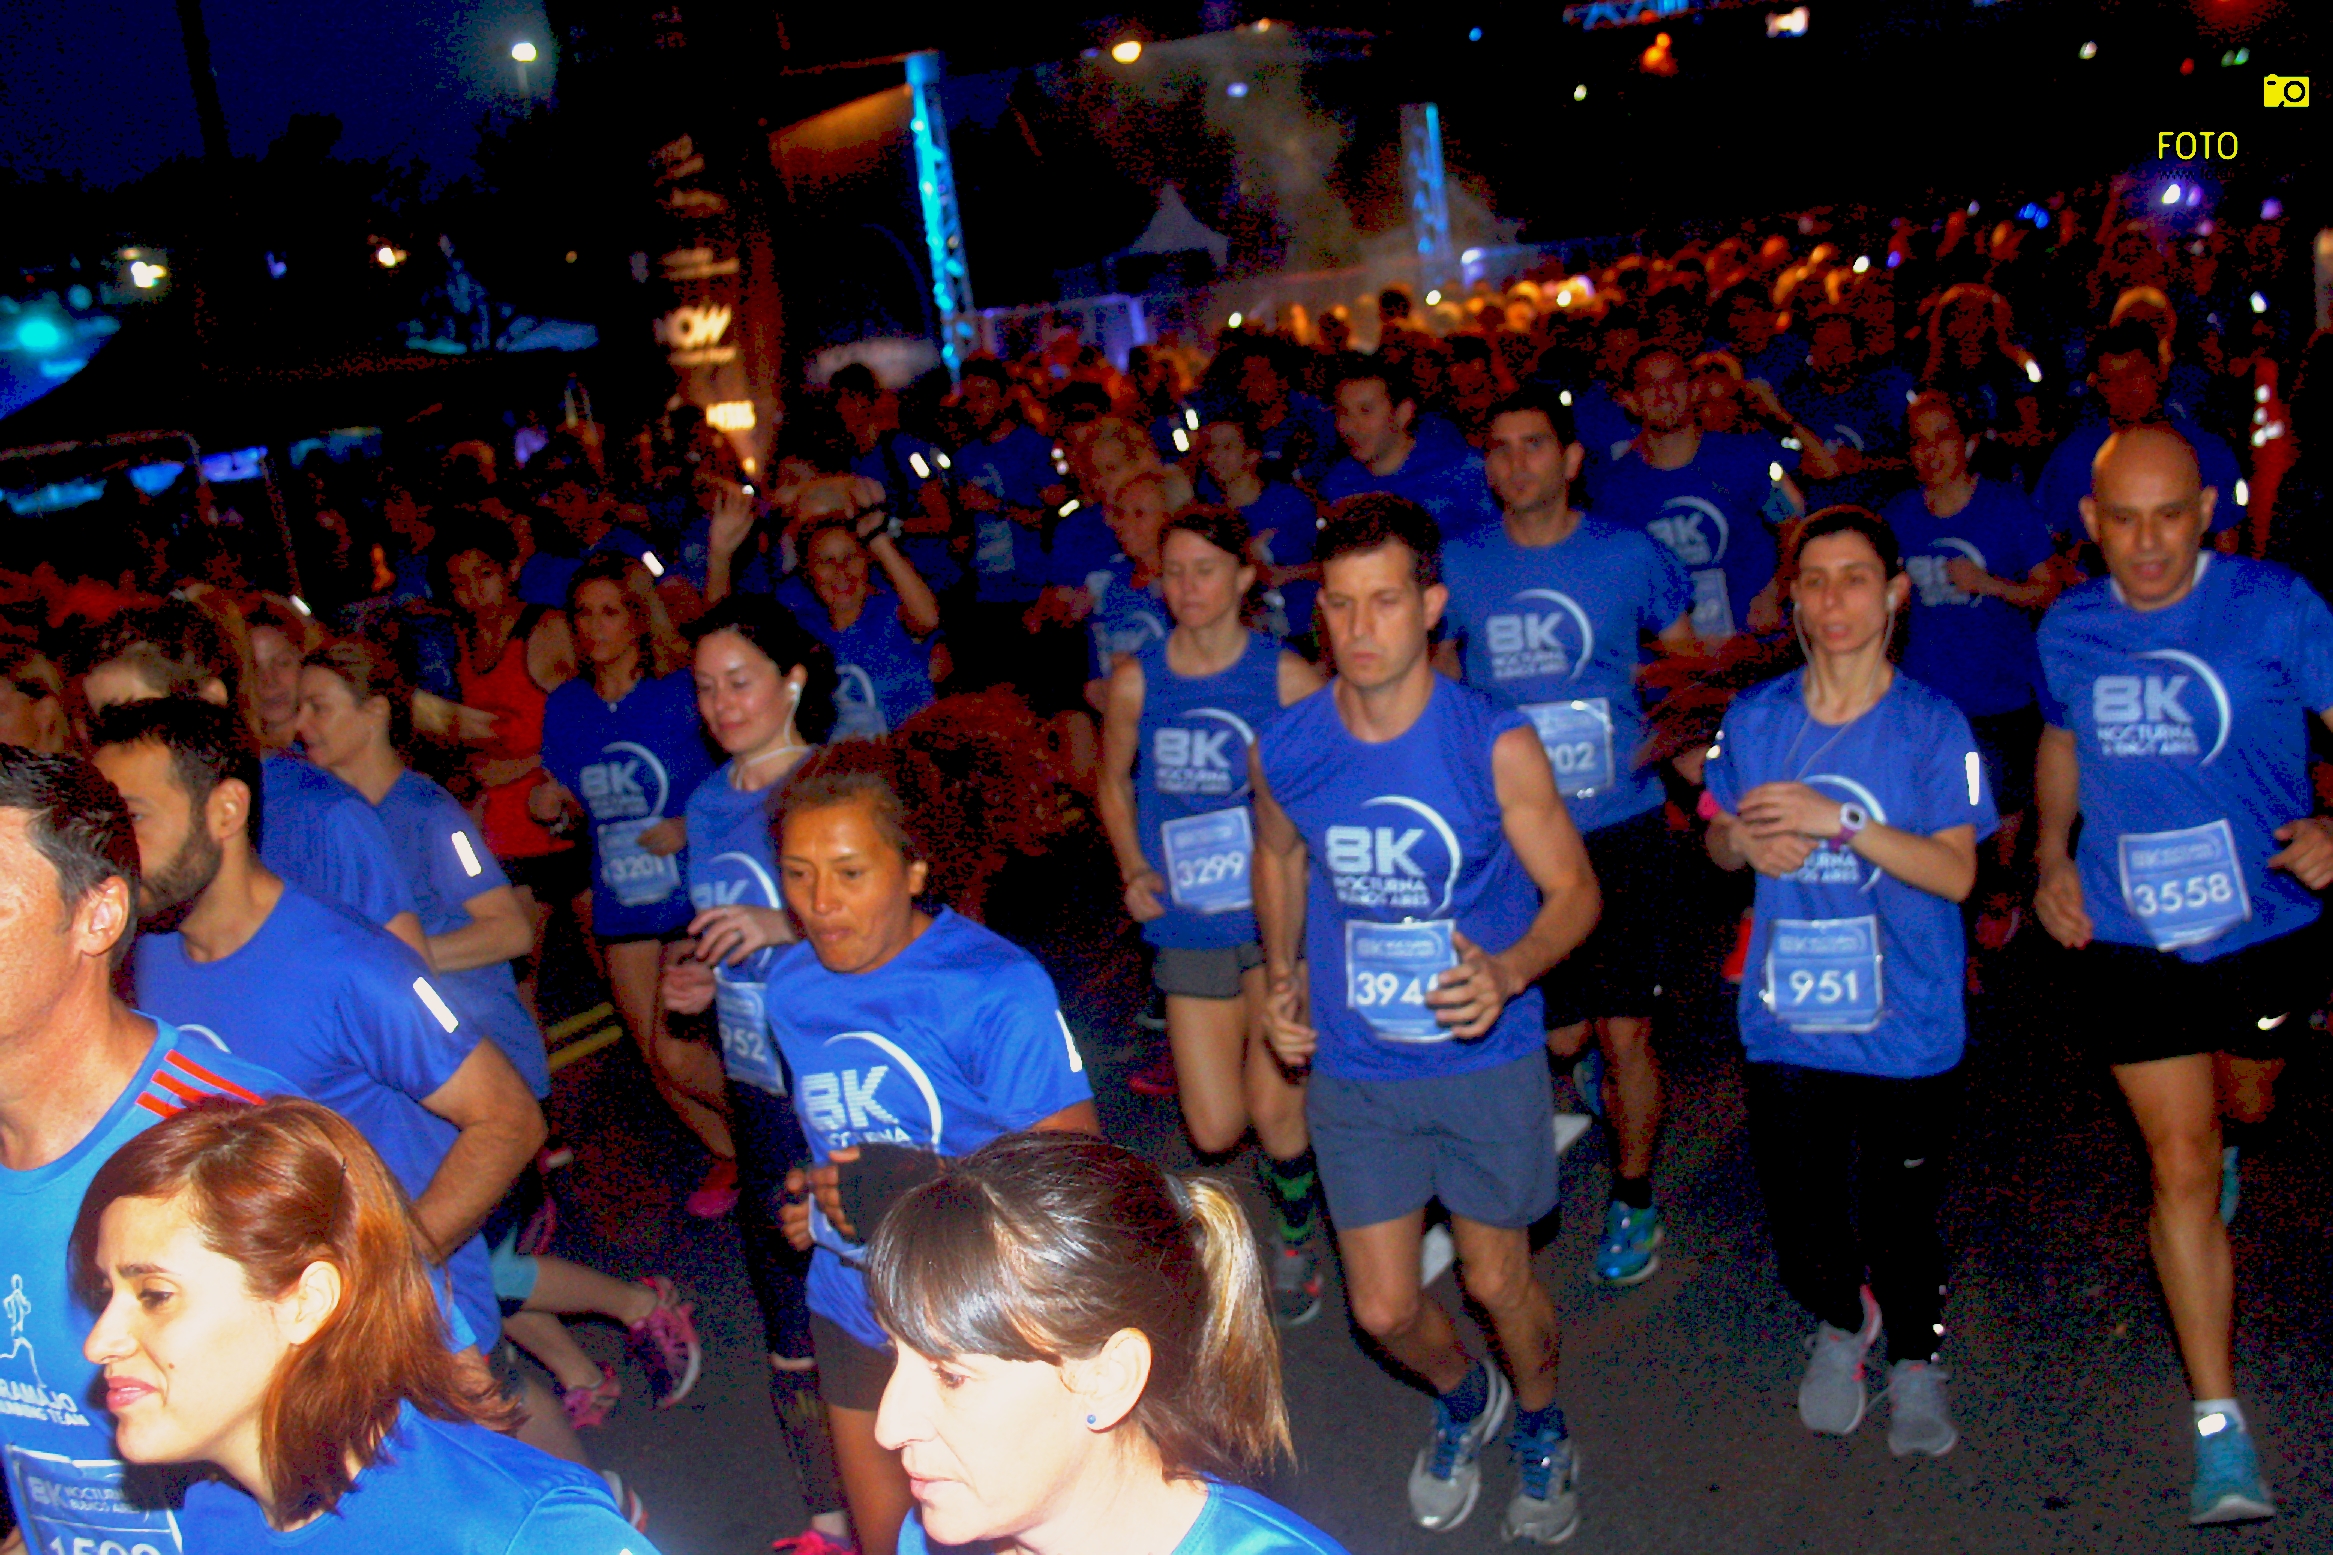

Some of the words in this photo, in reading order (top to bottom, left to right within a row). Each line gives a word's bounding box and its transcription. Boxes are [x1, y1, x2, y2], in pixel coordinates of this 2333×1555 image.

[1487, 613, 1564, 652] 8K
[2092, 675, 2193, 723] 8K
[1154, 727, 1230, 767] 8K
[1547, 741, 1596, 775] 02
[580, 759, 644, 798] 8K
[1176, 851, 1245, 888] 3299
[1325, 825, 1427, 876] 8K
[2133, 871, 2234, 918] 3558
[1355, 971, 1439, 1007] 394
[1789, 968, 1860, 1006] 951
[801, 1065, 900, 1130] 8K
